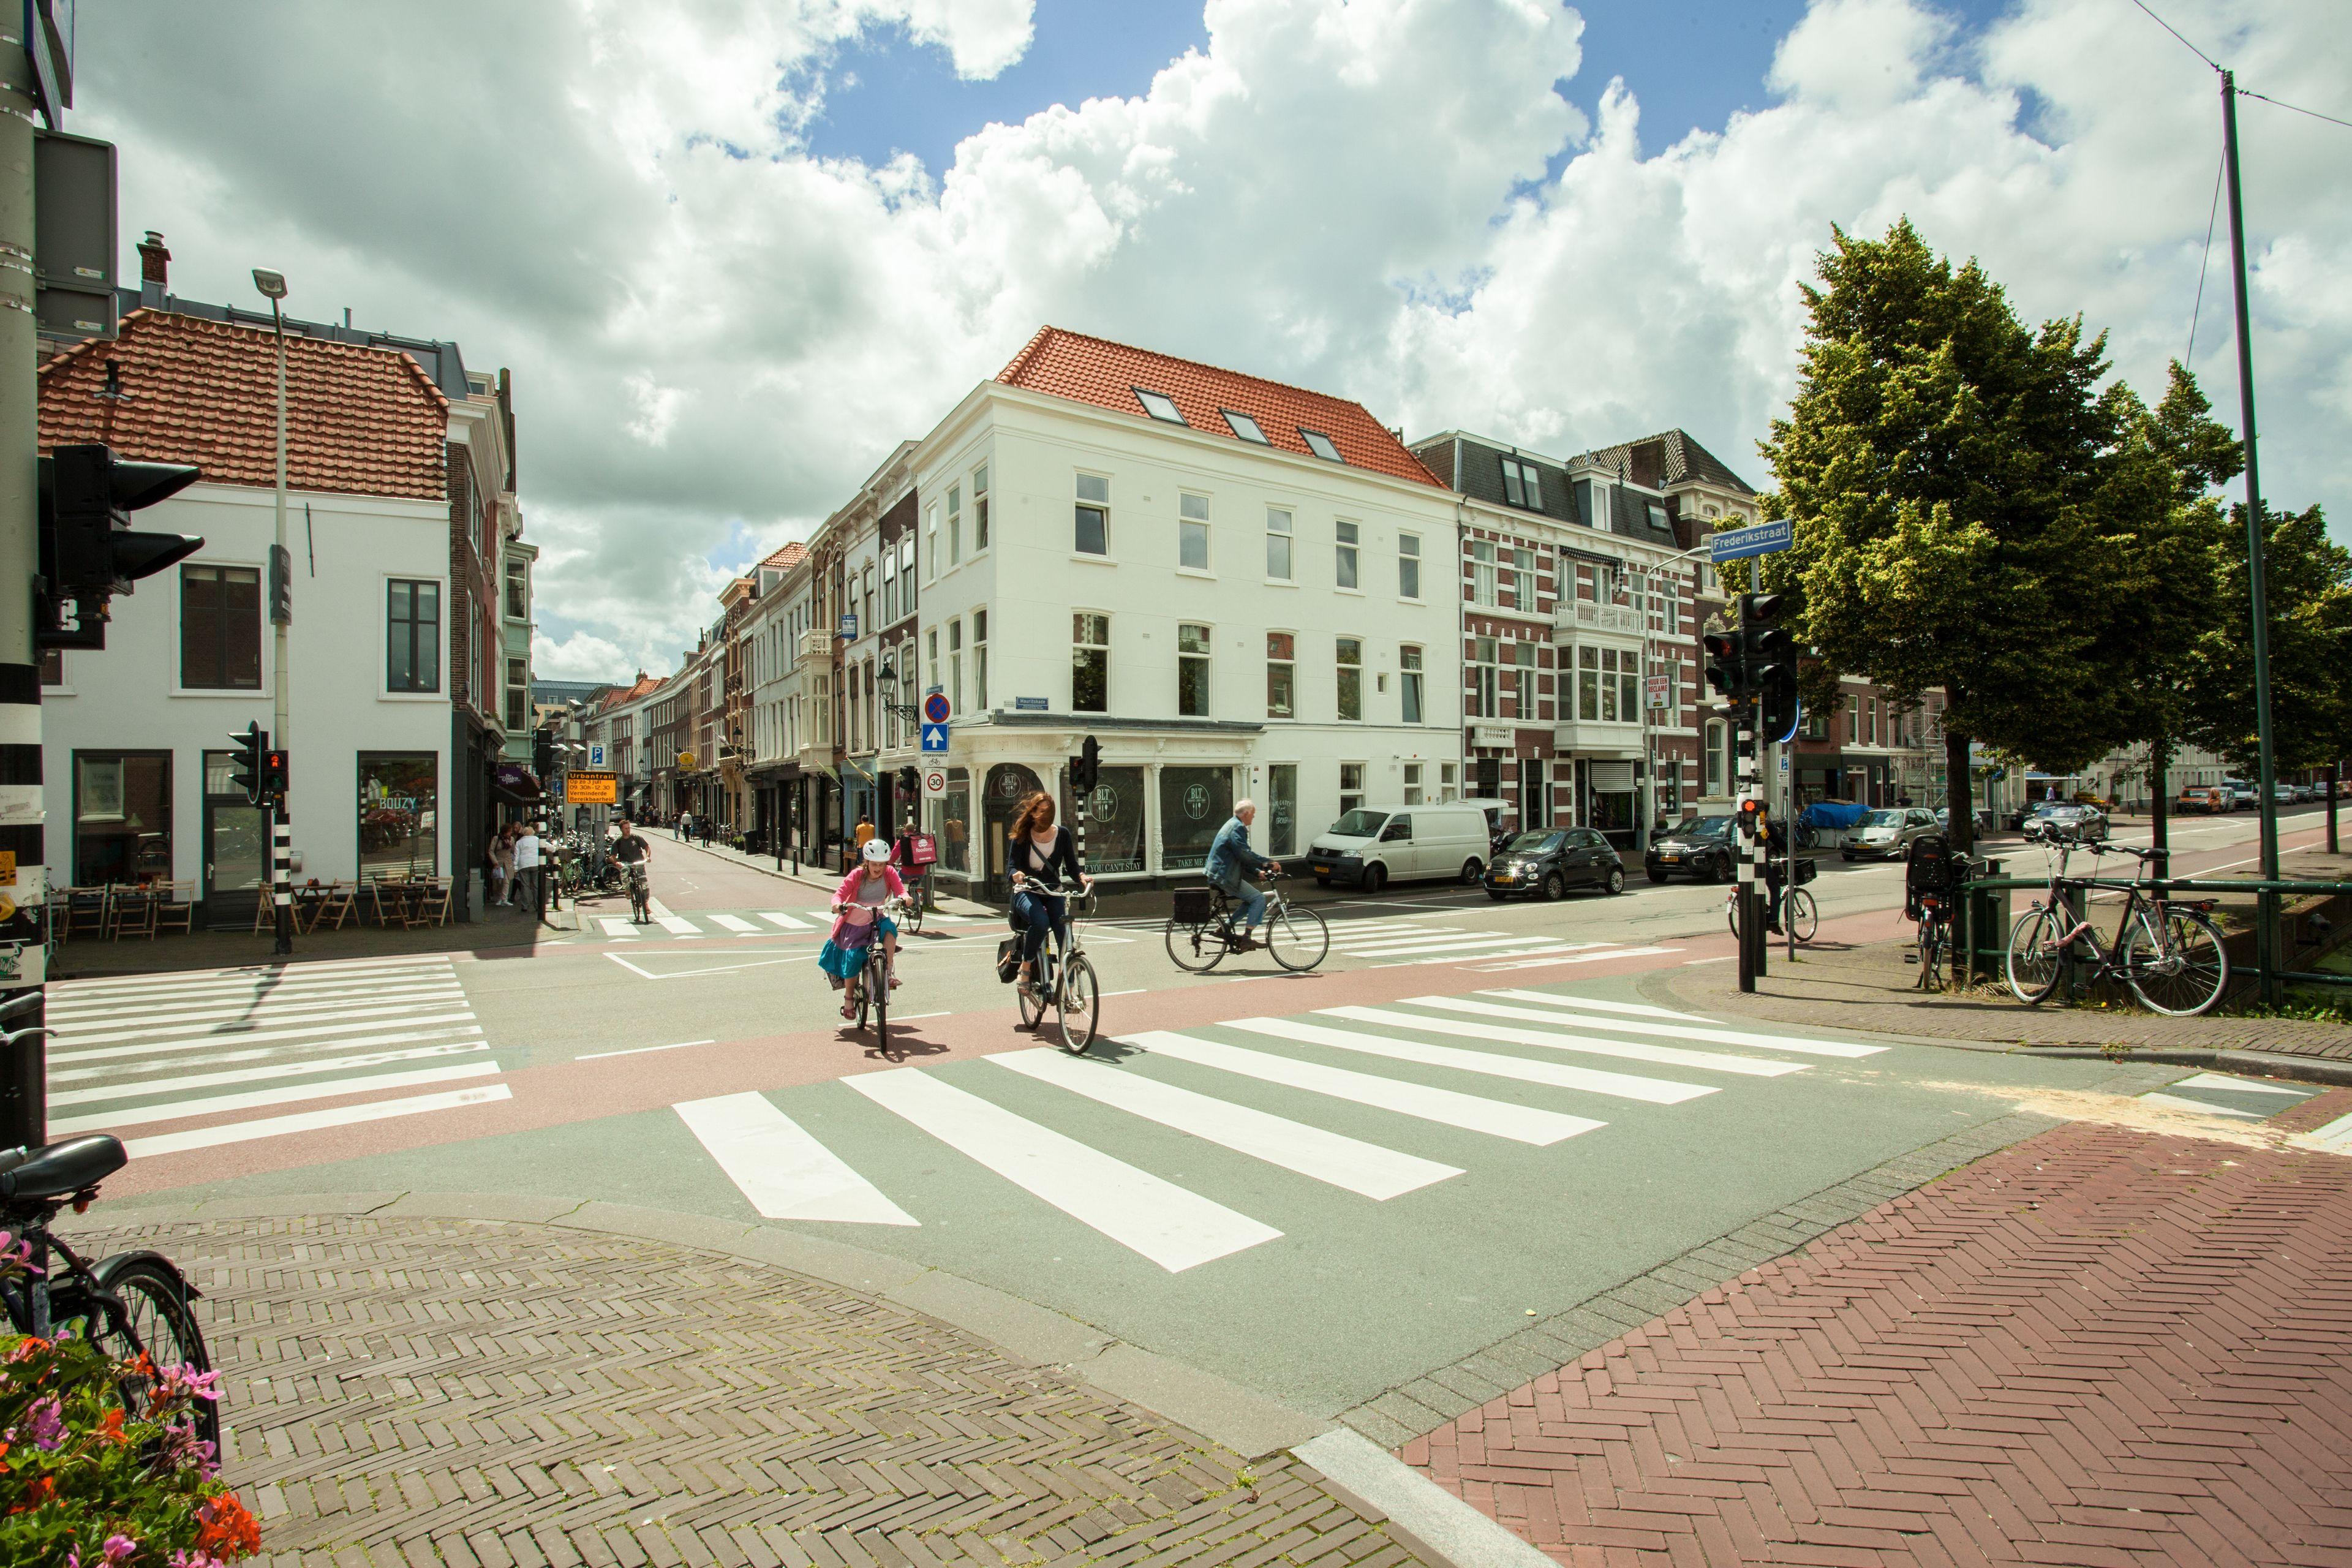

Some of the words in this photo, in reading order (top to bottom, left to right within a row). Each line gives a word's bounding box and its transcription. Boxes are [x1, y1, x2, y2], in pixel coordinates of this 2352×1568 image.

[1714, 525, 1786, 549] Frederikstraat
[1097, 789, 1110, 800] BLT
[1191, 788, 1202, 799] BLT
[380, 797, 417, 809] BOUZY
[1090, 864, 1104, 873] YOU
[1105, 863, 1125, 872] CAN'T
[1125, 862, 1141, 870] STAY
[1177, 859, 1193, 867] TAKE
